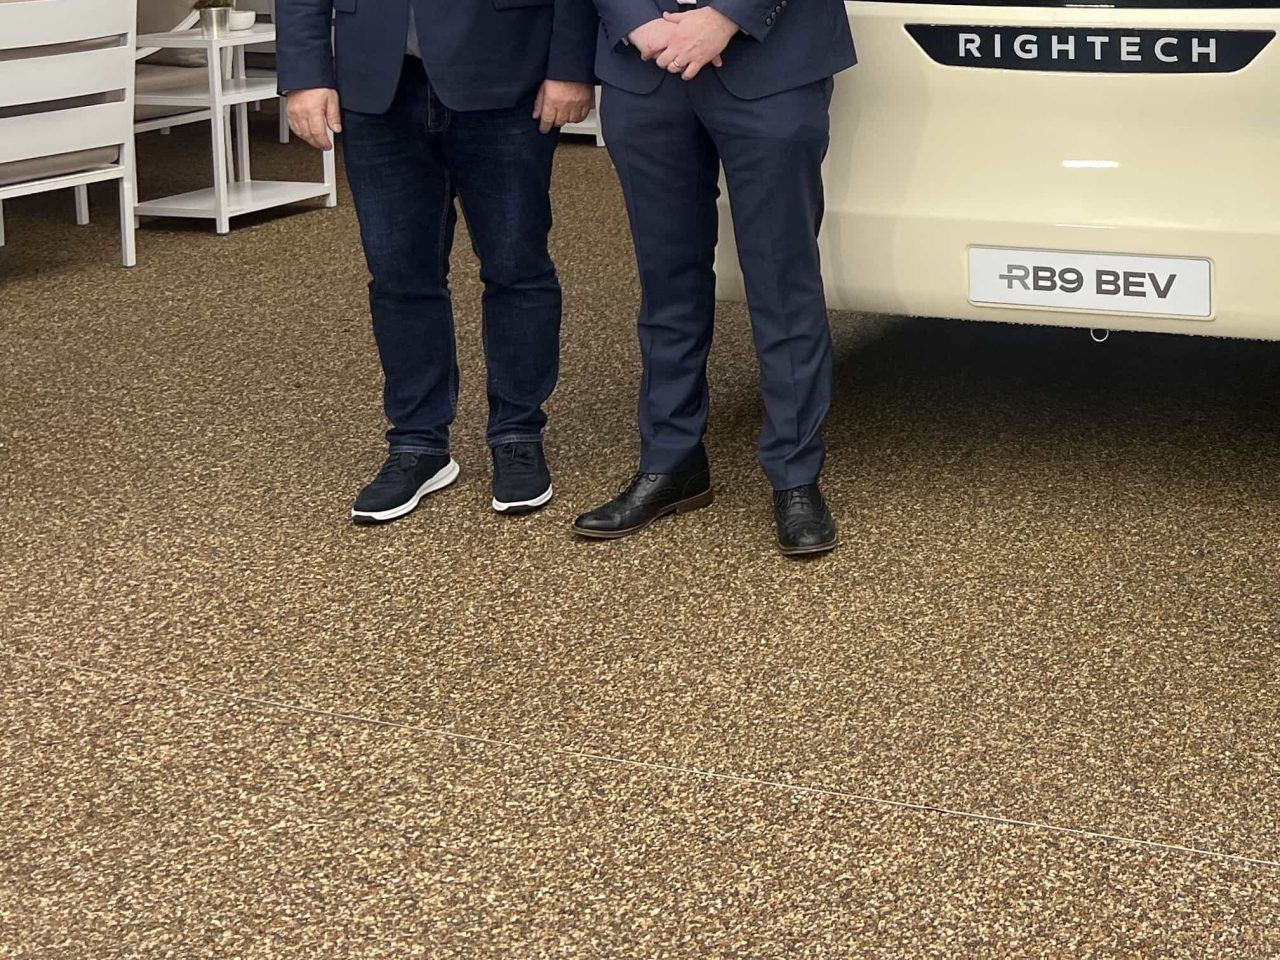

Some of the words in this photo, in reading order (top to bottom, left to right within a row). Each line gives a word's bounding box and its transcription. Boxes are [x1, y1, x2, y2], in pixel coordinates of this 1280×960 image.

[957, 32, 1218, 63] RIGHTECH
[998, 262, 1084, 294] RB9
[1095, 269, 1177, 299] BEV
